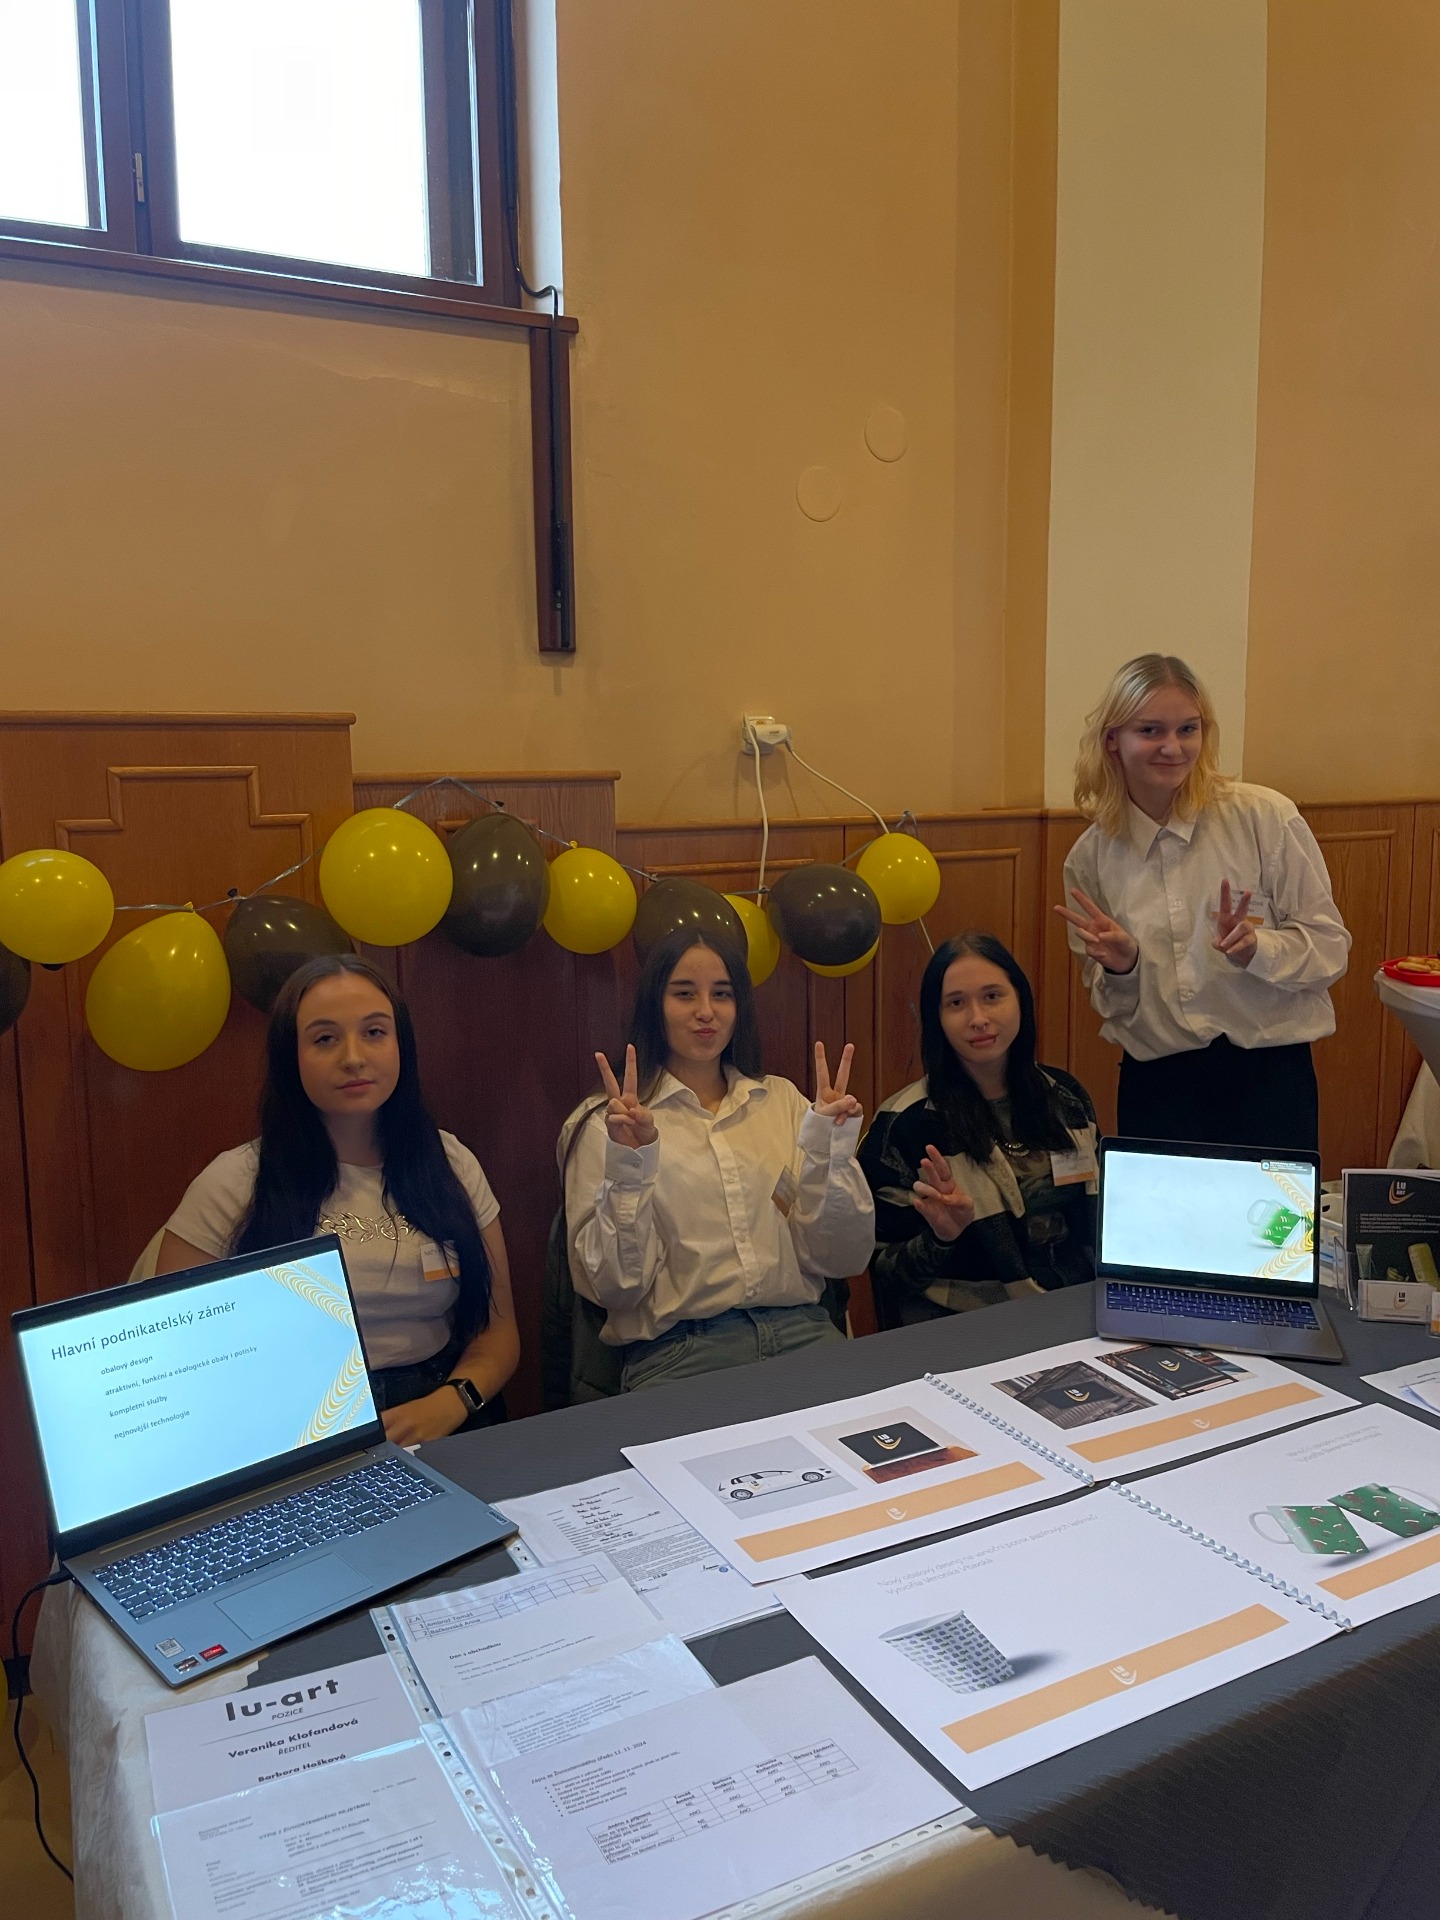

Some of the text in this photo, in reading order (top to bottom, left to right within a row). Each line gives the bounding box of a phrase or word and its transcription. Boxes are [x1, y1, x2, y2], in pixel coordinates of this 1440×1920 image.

[1396, 1181, 1407, 1190] LU
[51, 1301, 236, 1360] Hlavní podnikatelský záměr
[101, 1355, 153, 1375] obalový design
[105, 1381, 141, 1396] atraktivní,
[141, 1371, 167, 1386] funkční
[174, 1359, 210, 1375] ekologické
[211, 1354, 229, 1364] obaly
[234, 1346, 258, 1358] potisky
[109, 1394, 168, 1418] kompletní služby
[114, 1409, 190, 1439] nejnovější technologie
[452, 1612, 473, 1621] Tomáš
[225, 1679, 339, 1721] lu-art
[271, 1707, 304, 1720] POZICE
[228, 1718, 359, 1758] Veronika Klofandová
[278, 1741, 312, 1756] ŘEDITEL
[633, 1740, 647, 1749] 2024
[258, 1753, 346, 1782] Barbora Hošková
[819, 1760, 831, 1768] ANO
[774, 1776, 786, 1784] ANO
[723, 1785, 735, 1793] ANO
[780, 1784, 792, 1792] ANO
[729, 1793, 741, 1801] ANO
[689, 1809, 701, 1817] ANO
[739, 1807, 751, 1815] ANO
